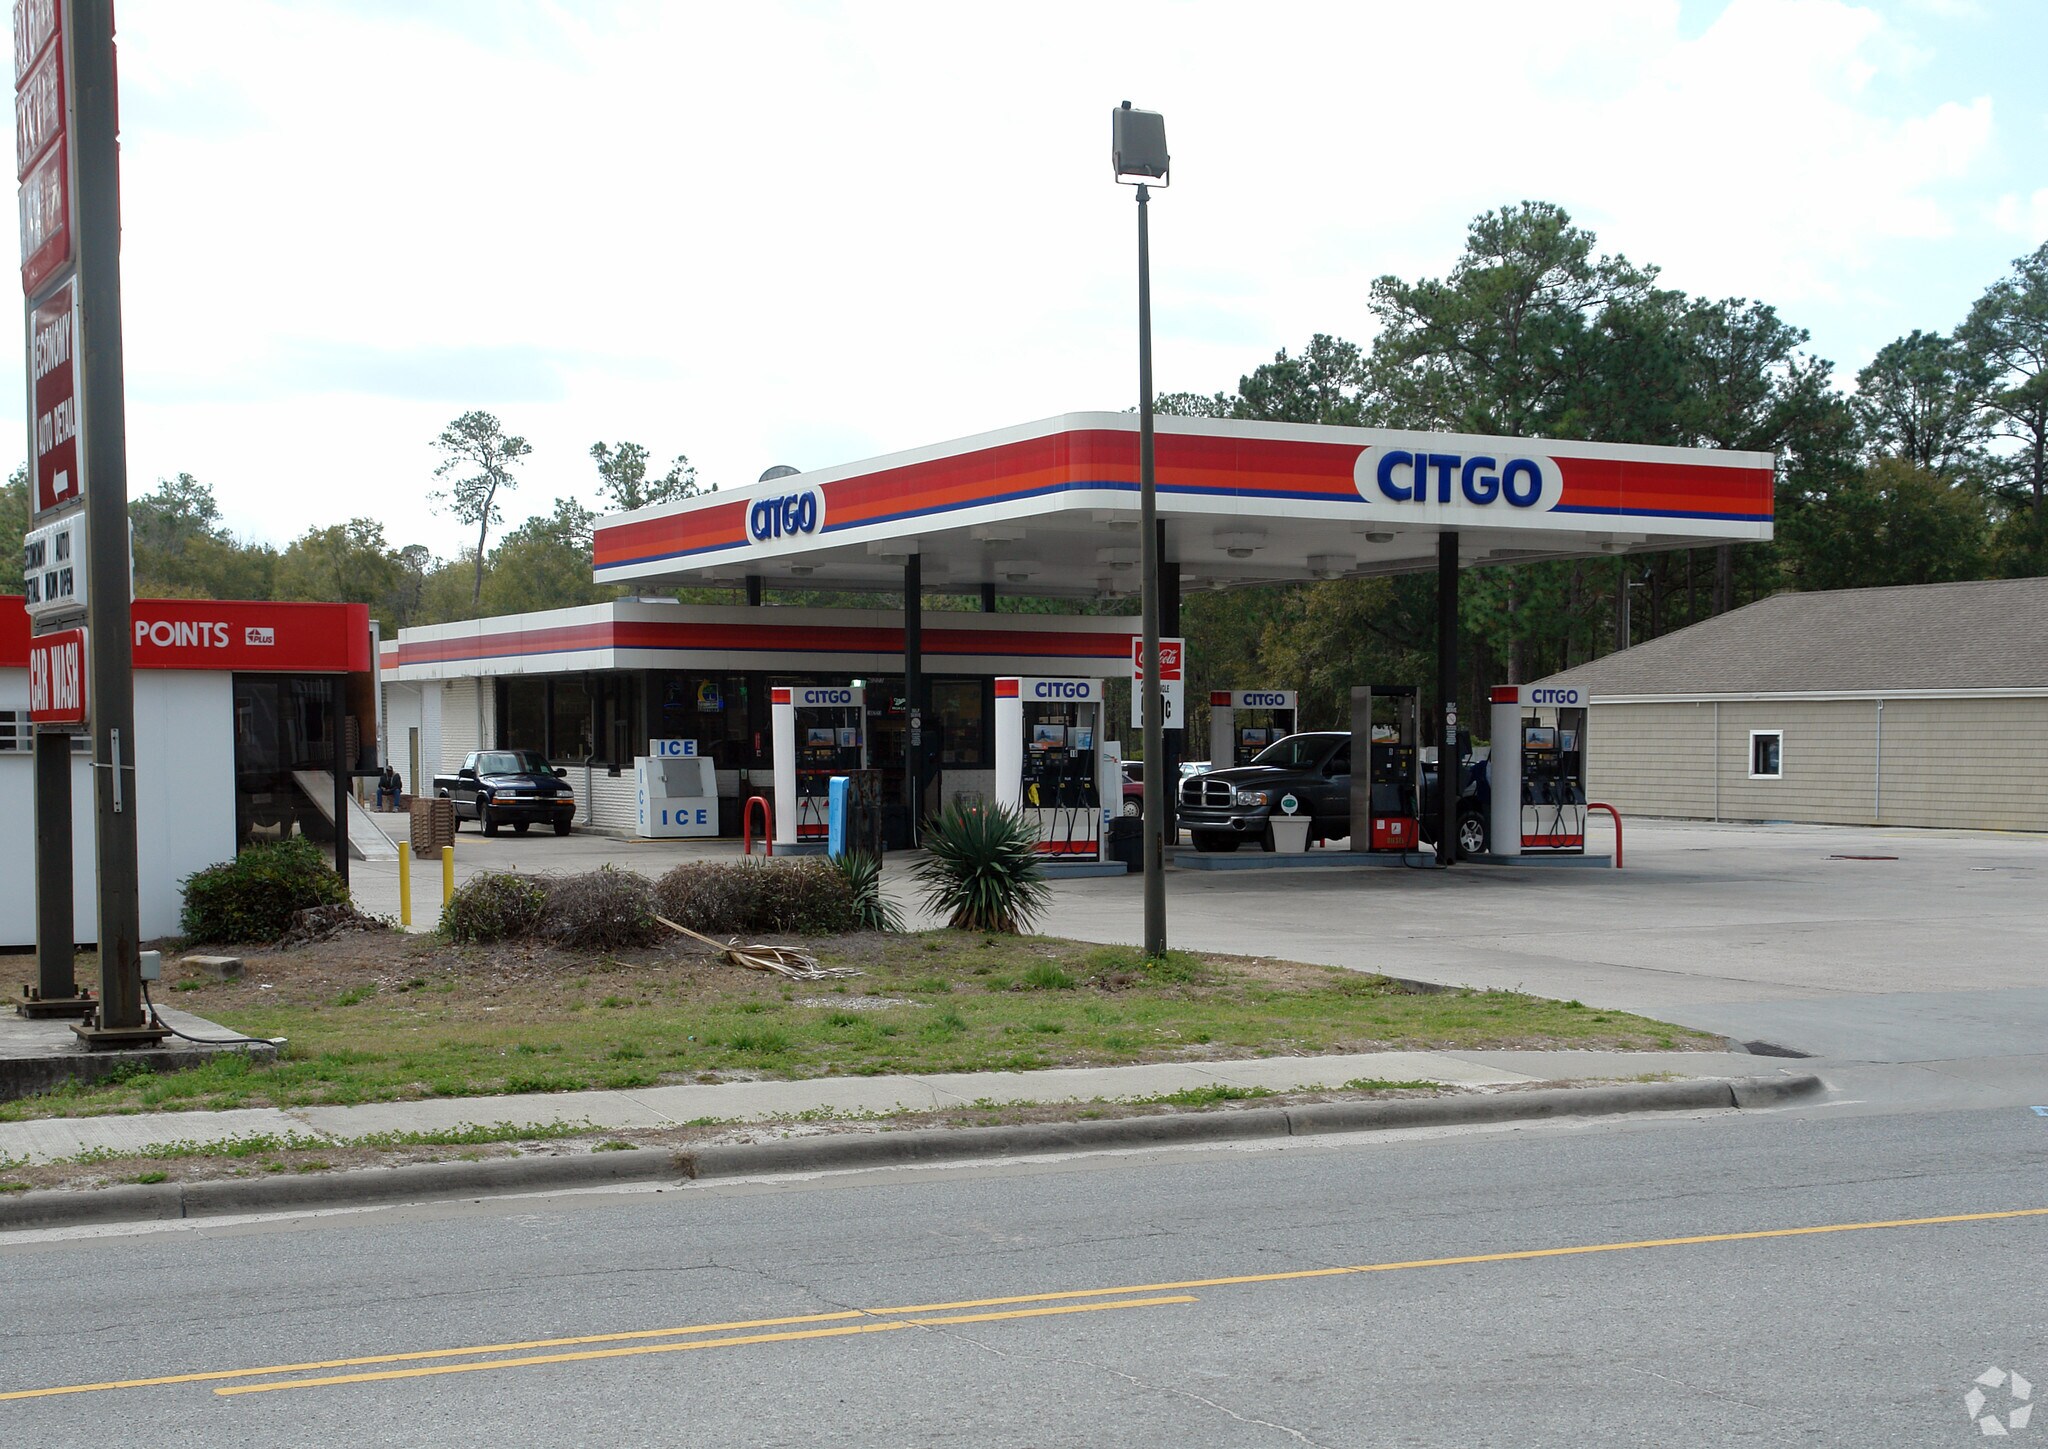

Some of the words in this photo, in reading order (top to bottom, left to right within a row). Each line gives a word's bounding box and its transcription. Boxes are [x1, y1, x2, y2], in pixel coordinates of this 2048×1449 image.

[36, 311, 71, 380] ECONOMY
[38, 411, 53, 457] AUTO
[54, 396, 76, 446] DETAIL
[1377, 450, 1543, 507] CITGO
[751, 490, 817, 541] CITGO
[56, 531, 70, 562] AUTO
[45, 571, 58, 602] NOW
[60, 566, 73, 597] OPEN
[135, 620, 229, 648] POINTS
[253, 635, 273, 644] PLUS
[30, 648, 49, 712] CAR
[51, 642, 80, 710] WASH
[1035, 682, 1090, 698] CITGO
[804, 690, 852, 704] CITGO
[1243, 693, 1285, 706] CITGO
[1532, 689, 1578, 704] CITGO
[660, 741, 694, 755] ICE
[662, 809, 707, 825] ICE
